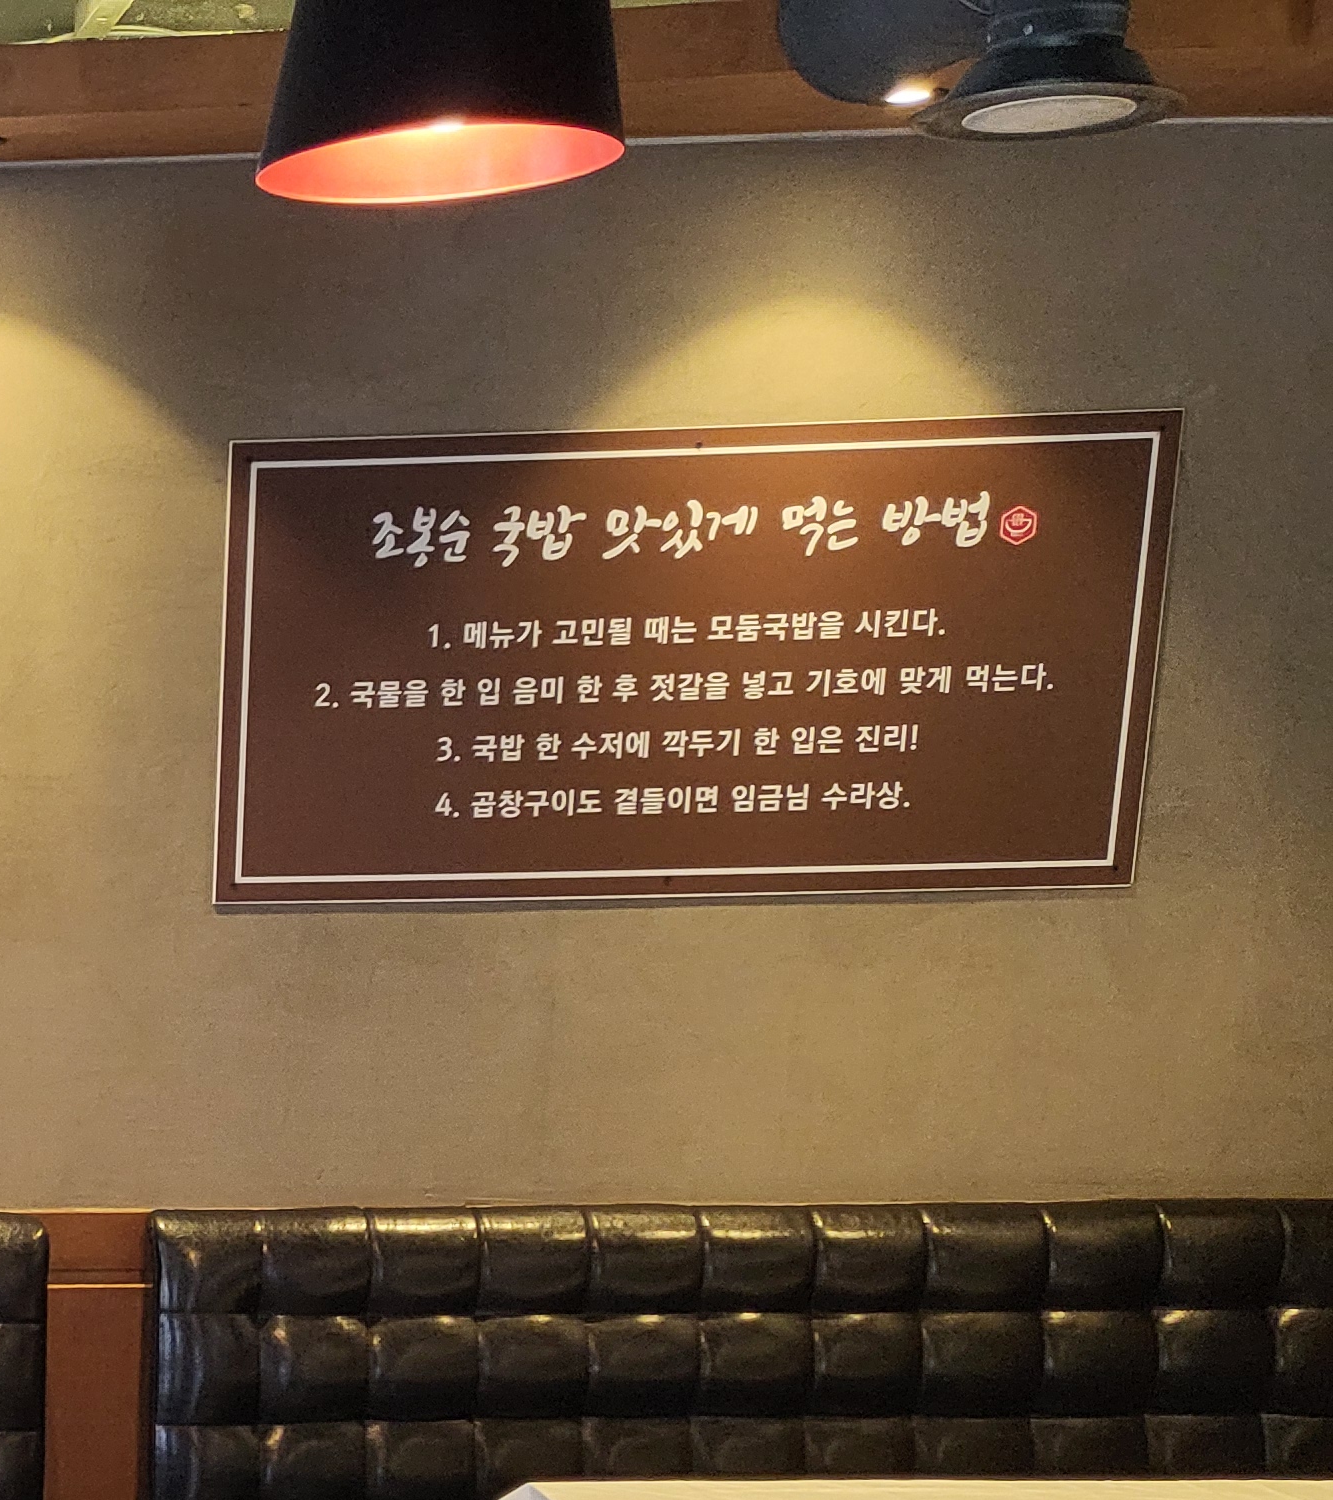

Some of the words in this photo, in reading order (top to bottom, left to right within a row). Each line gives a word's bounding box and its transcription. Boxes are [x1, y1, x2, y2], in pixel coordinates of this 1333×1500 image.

[372, 506, 471, 568] 조봉순
[492, 504, 587, 568] 국밥
[602, 499, 759, 560] 맛있게
[781, 495, 859, 557] 먹는
[881, 490, 990, 548] 방법
[428, 623, 451, 649] 1.
[463, 619, 543, 649] 메뉴가
[552, 617, 632, 646] 고민될
[644, 615, 697, 645] 때는
[707, 610, 845, 642] 모둠국밥을
[854, 608, 945, 639] 시킨다.
[314, 682, 339, 708] 2.
[350, 679, 429, 709] 국물을
[441, 678, 466, 707] 한
[477, 677, 501, 706] 입
[512, 676, 564, 705] 음미
[577, 675, 603, 703] 한
[612, 673, 639, 703] 후
[649, 671, 730, 702] 젓갈을
[742, 670, 794, 700] 넣고
[806, 667, 887, 698] 기호에
[900, 665, 952, 695] 맞게
[965, 662, 1054, 693] 먹는다.
[436, 736, 461, 762] 3.
[472, 733, 526, 763] 국밥
[536, 733, 562, 761] 한
[571, 730, 650, 760] 수저에
[662, 728, 741, 758] 깍두기
[754, 727, 780, 756] 한
[791, 725, 844, 755] 입은
[855, 724, 919, 753] 진리!
[434, 792, 460, 818] 4.
[470, 788, 602, 819] 곱창구이도
[614, 785, 719, 815] 곁들이면
[731, 783, 810, 813] 임금님
[821, 781, 910, 811] 수라상.
